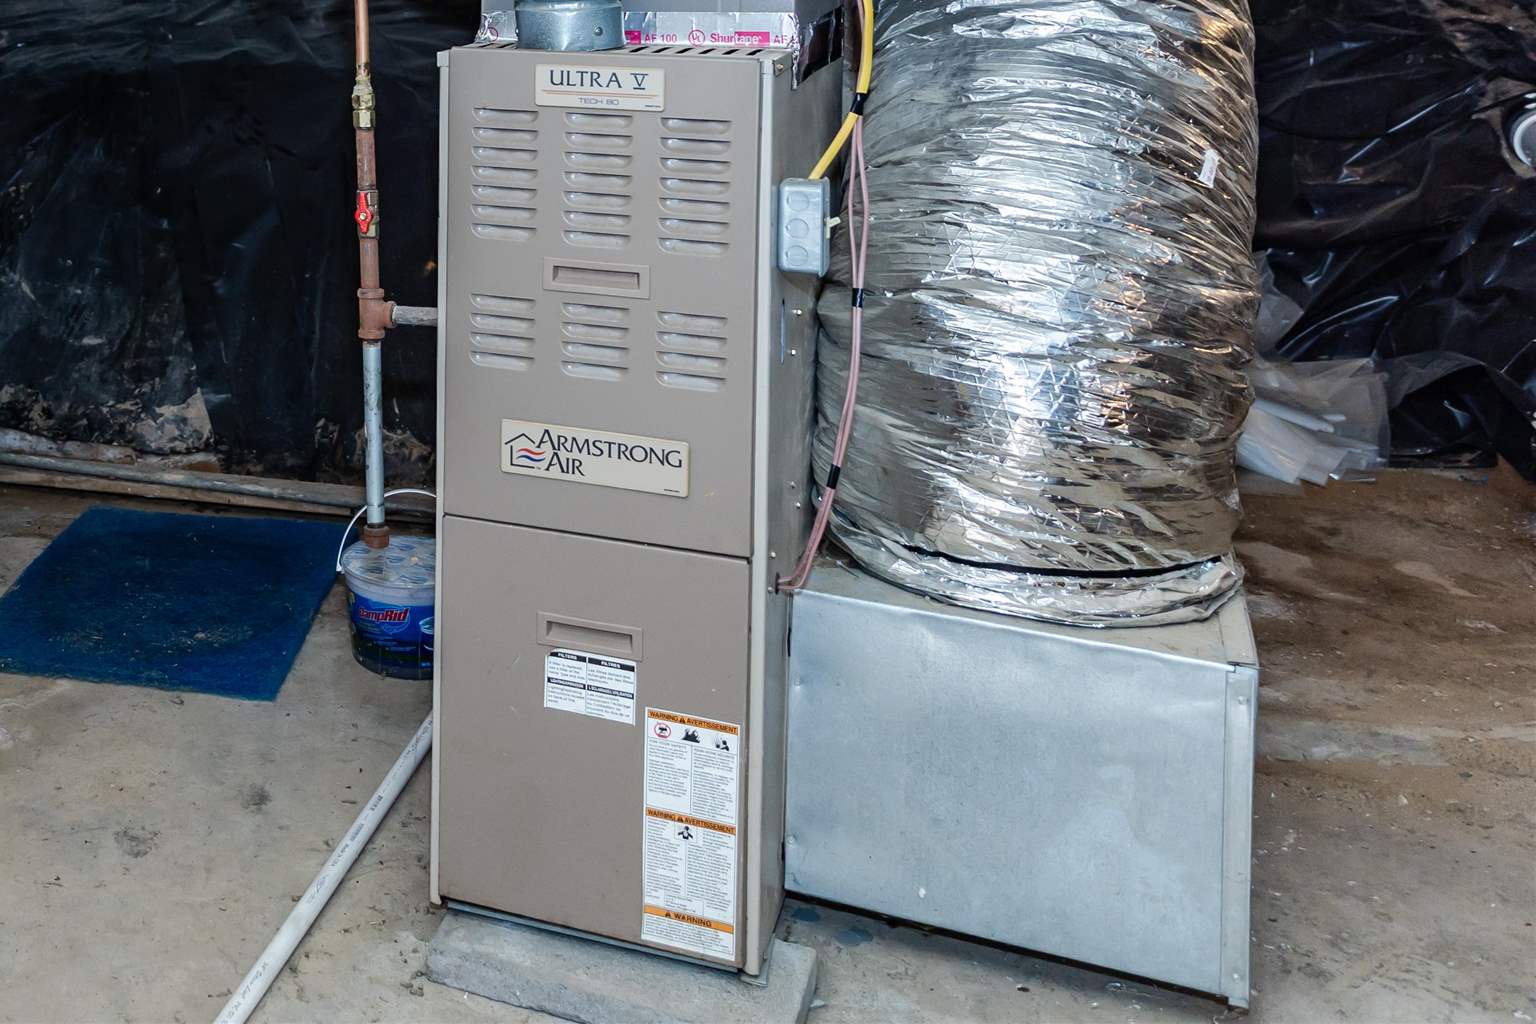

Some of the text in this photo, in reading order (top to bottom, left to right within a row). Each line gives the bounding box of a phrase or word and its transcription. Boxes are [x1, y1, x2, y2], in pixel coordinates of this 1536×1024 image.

[644, 33, 657, 44] AF
[661, 33, 677, 43] 100
[709, 32, 760, 45] Shurtape
[549, 69, 649, 90] ULTRA V
[536, 429, 683, 469] ARMSTRONG
[544, 451, 586, 477] AIR
[674, 911, 713, 928] WARNING
